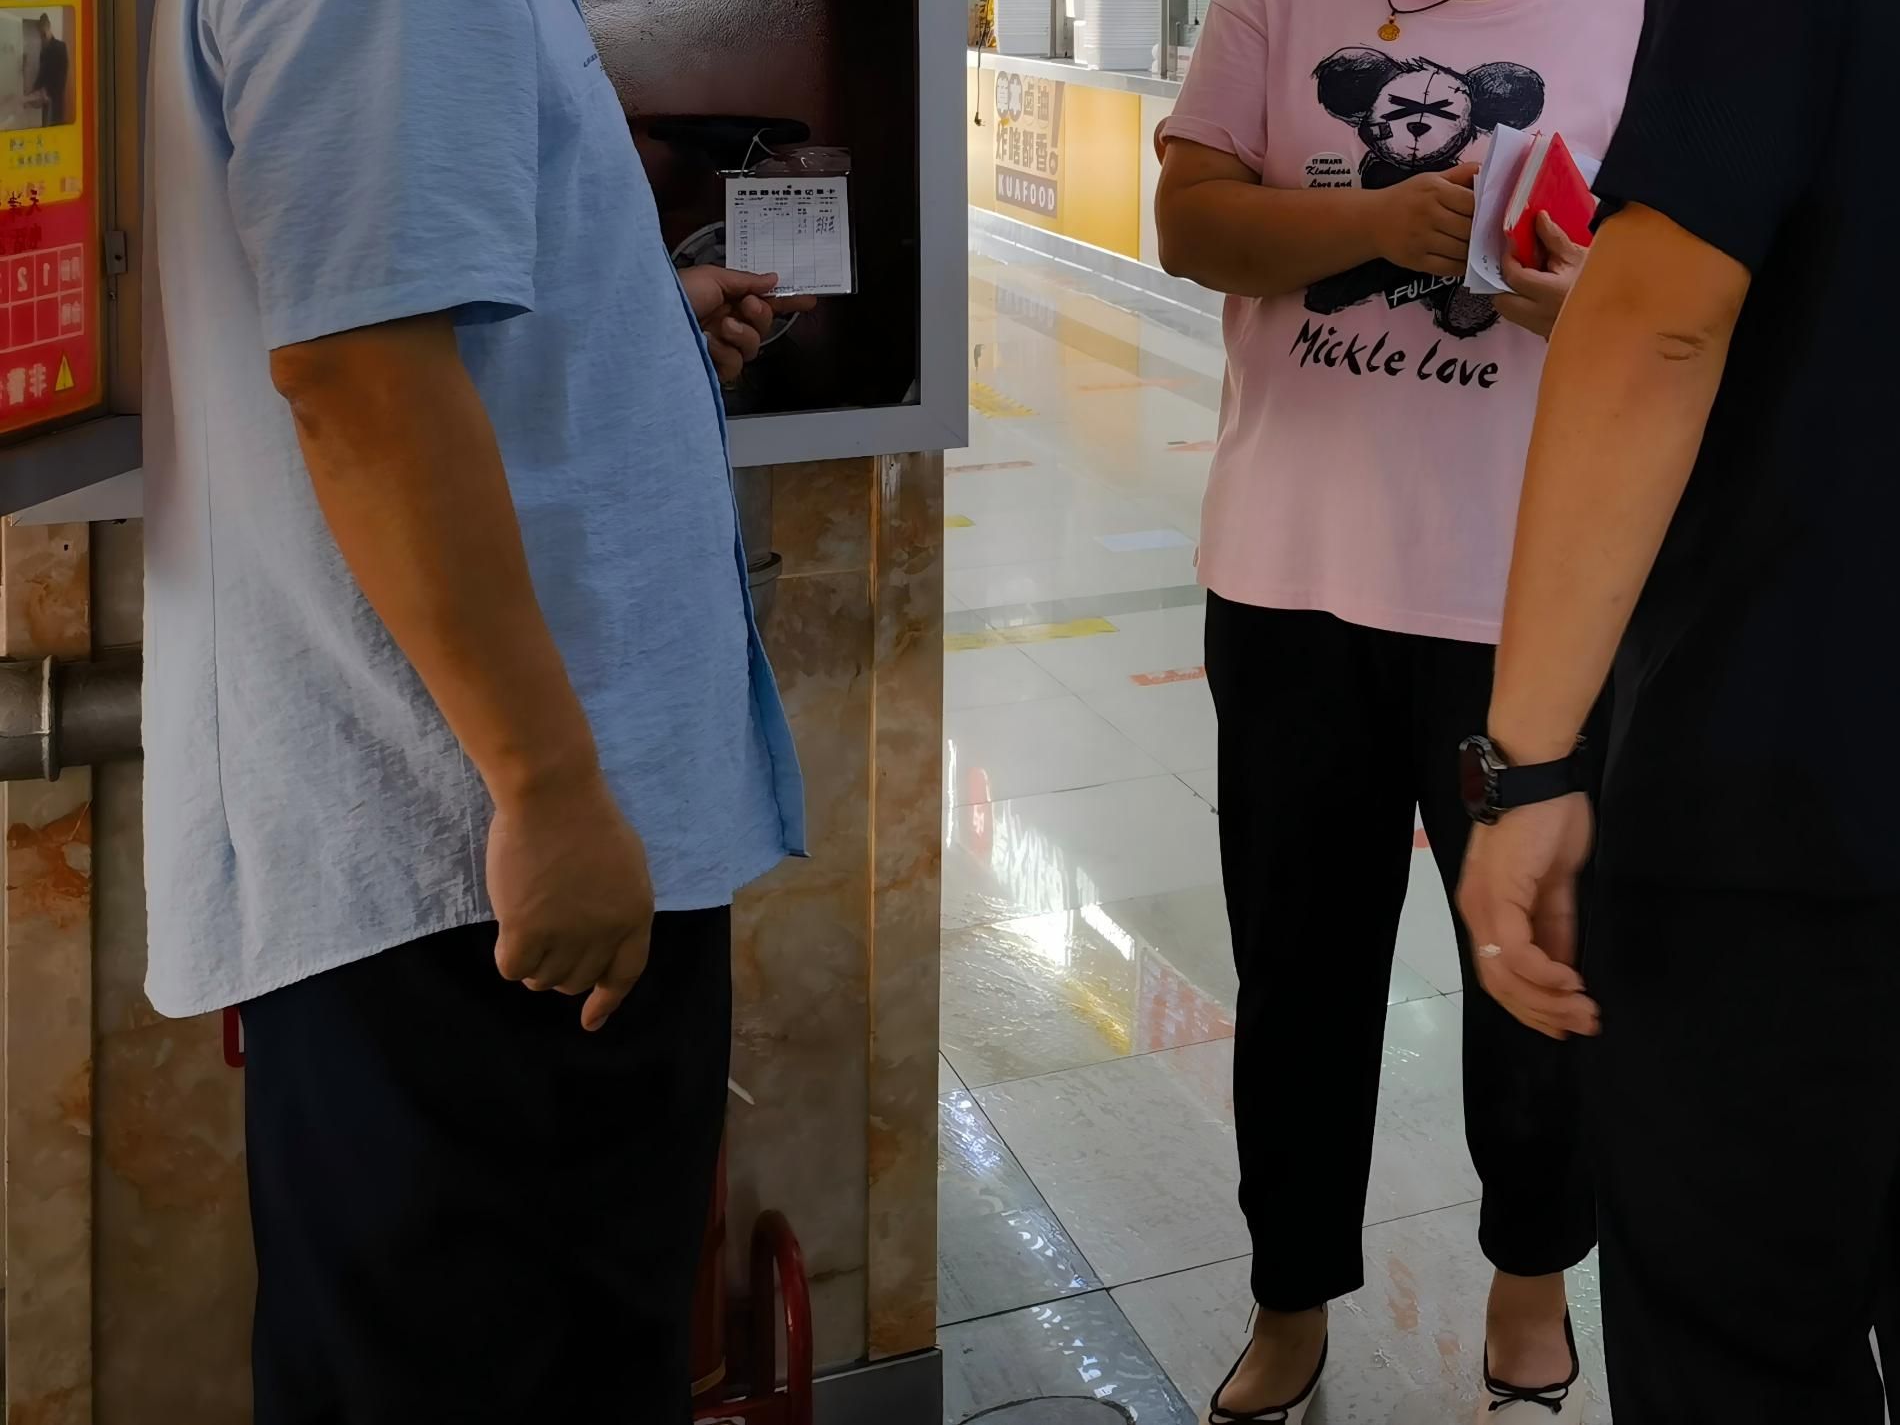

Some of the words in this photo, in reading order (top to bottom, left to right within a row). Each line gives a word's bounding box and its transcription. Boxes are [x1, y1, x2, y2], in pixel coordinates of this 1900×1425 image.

[1305, 165, 1351, 175] Kindness
[998, 174, 1056, 211] KUAFOOD
[1334, 179, 1352, 188] and
[1290, 318, 1406, 376] Mickle
